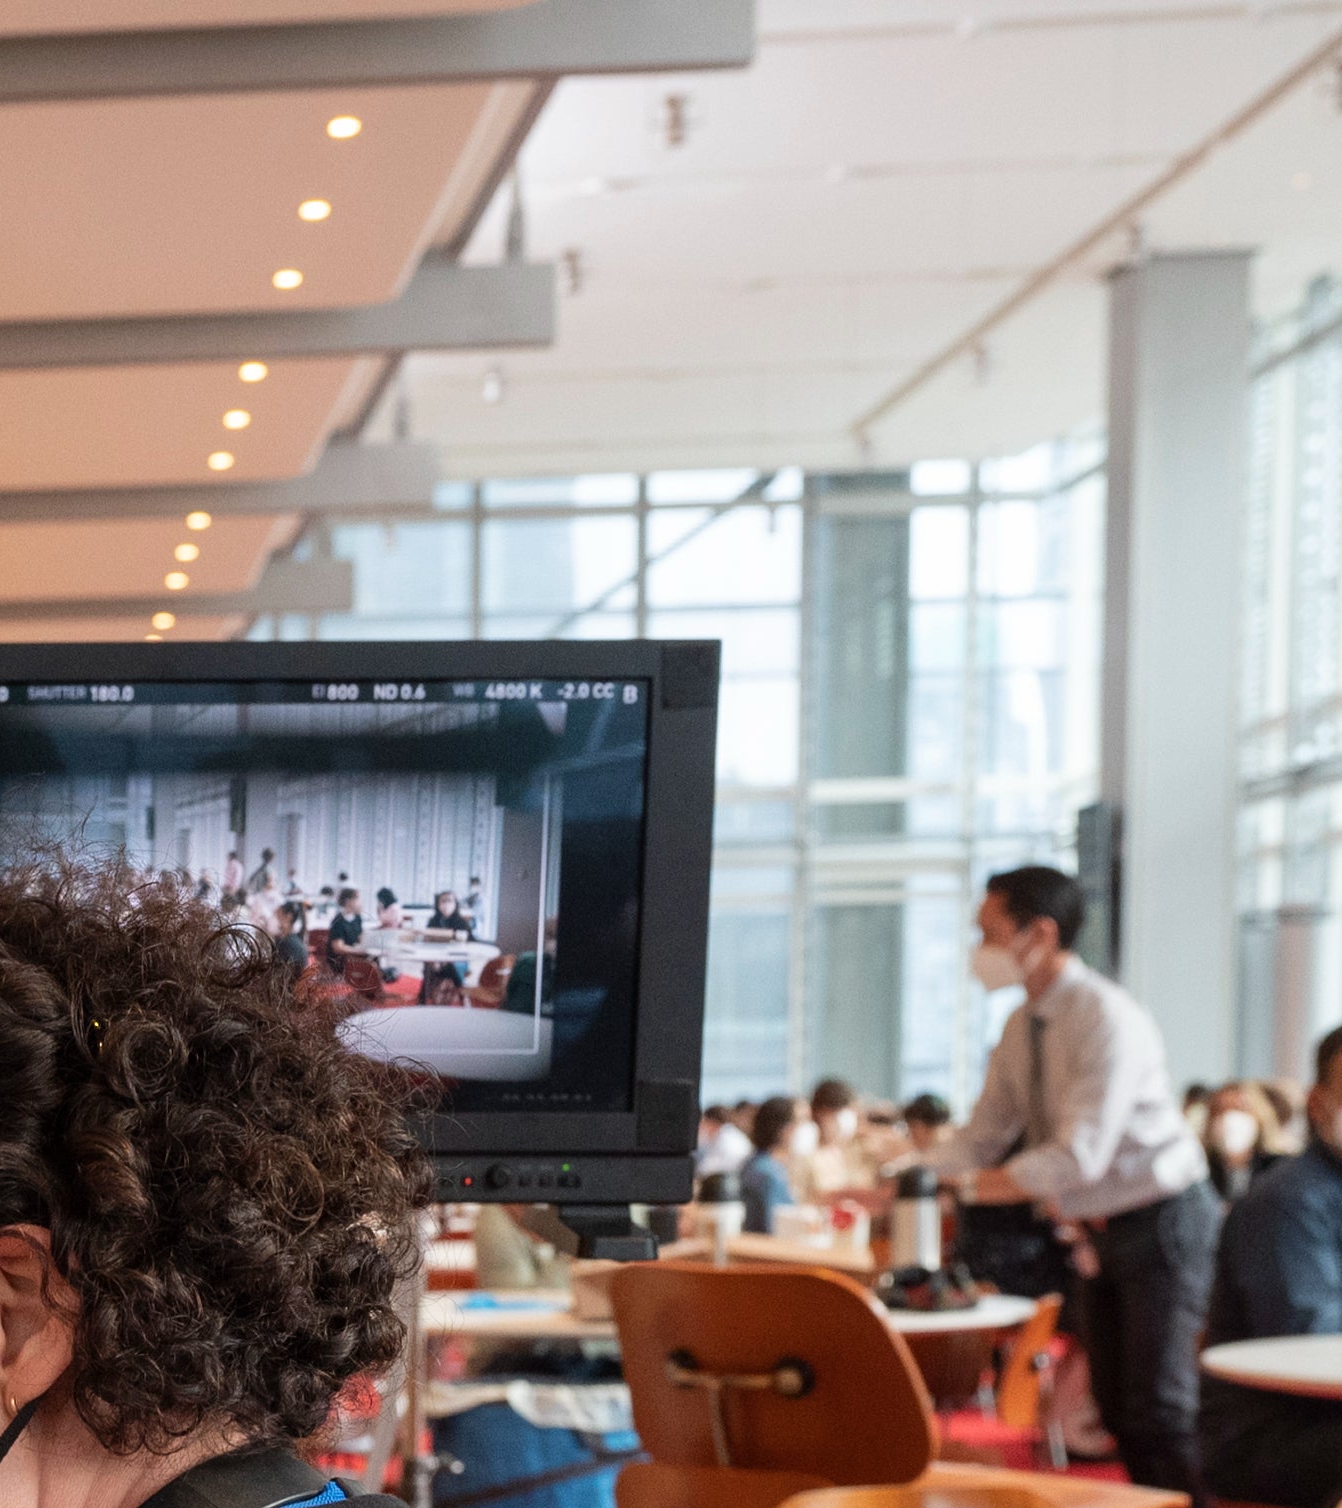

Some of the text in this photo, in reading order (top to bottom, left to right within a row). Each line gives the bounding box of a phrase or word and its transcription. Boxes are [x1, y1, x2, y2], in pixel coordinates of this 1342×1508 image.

[26, 684, 87, 700] SHUTTER
[90, 684, 135, 703] 180.0
[326, 683, 360, 701] 800
[373, 683, 399, 701] ND
[400, 683, 426, 701] 0.6
[484, 682, 527, 700] 4800
[529, 682, 543, 700] K
[557, 682, 590, 700] -2.0
[591, 682, 616, 699] CC
[622, 684, 639, 704] B
